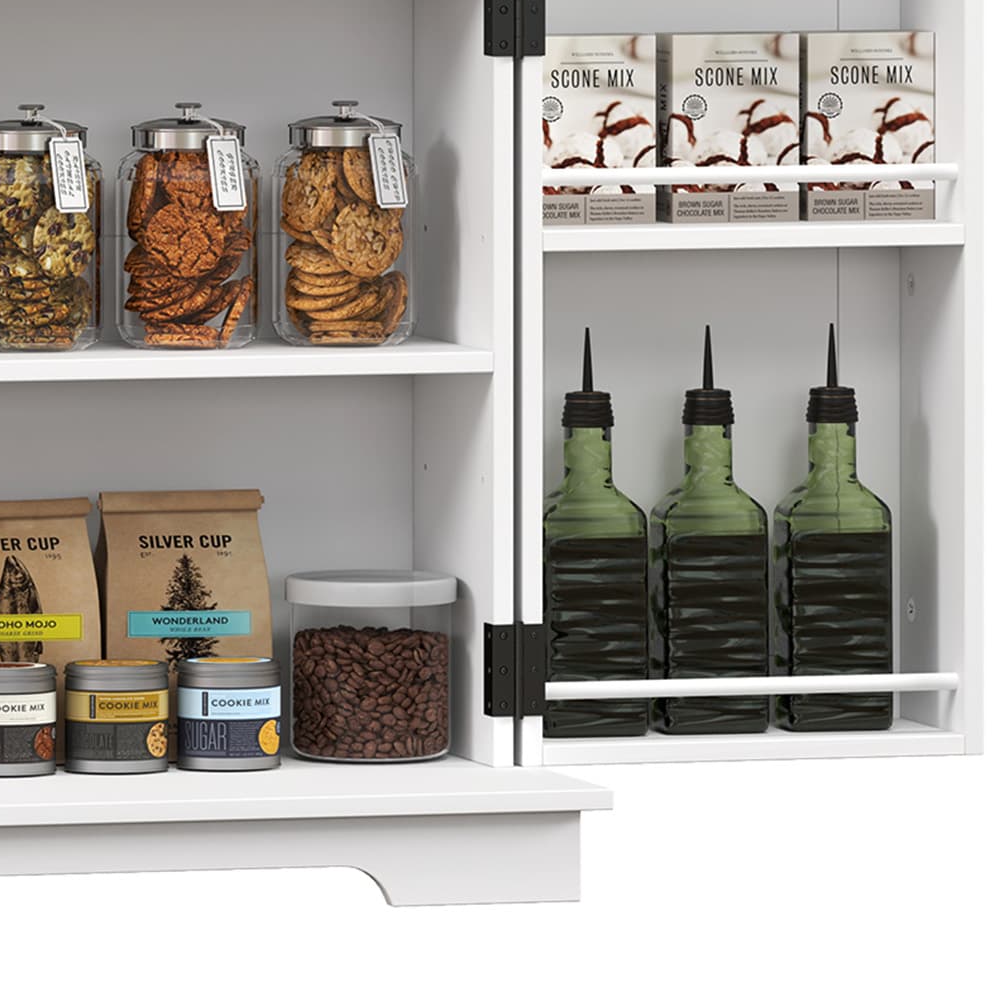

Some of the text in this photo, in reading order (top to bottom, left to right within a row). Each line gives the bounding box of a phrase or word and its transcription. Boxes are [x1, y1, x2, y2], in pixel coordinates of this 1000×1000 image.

[550, 69, 634, 88] SCONE MIX
[695, 67, 778, 87] SCONE MIX
[830, 65, 913, 85] SCONE MIX
[56, 153, 67, 196] COOKIES
[65, 150, 74, 197] OATMEAL
[216, 150, 228, 193] COOKIES
[226, 152, 238, 191] GINGER
[377, 147, 390, 190] COOKIES
[678, 200, 723, 209] BROWN SUGAR
[814, 198, 858, 207] BROWN SUGAR
[543, 211, 568, 219] COLATE
[676, 209, 725, 217] CHOCOLATE MIX
[849, 207, 860, 215] MIX
[27, 537, 60, 551] CUP
[138, 534, 232, 549] SILVER CUP
[26, 620, 57, 629] MOJO
[152, 616, 229, 625] WONDERLAND
[98, 702, 140, 710] COOKIE
[211, 698, 270, 707] COOKIE MIX
[184, 721, 227, 751] SUGAR
